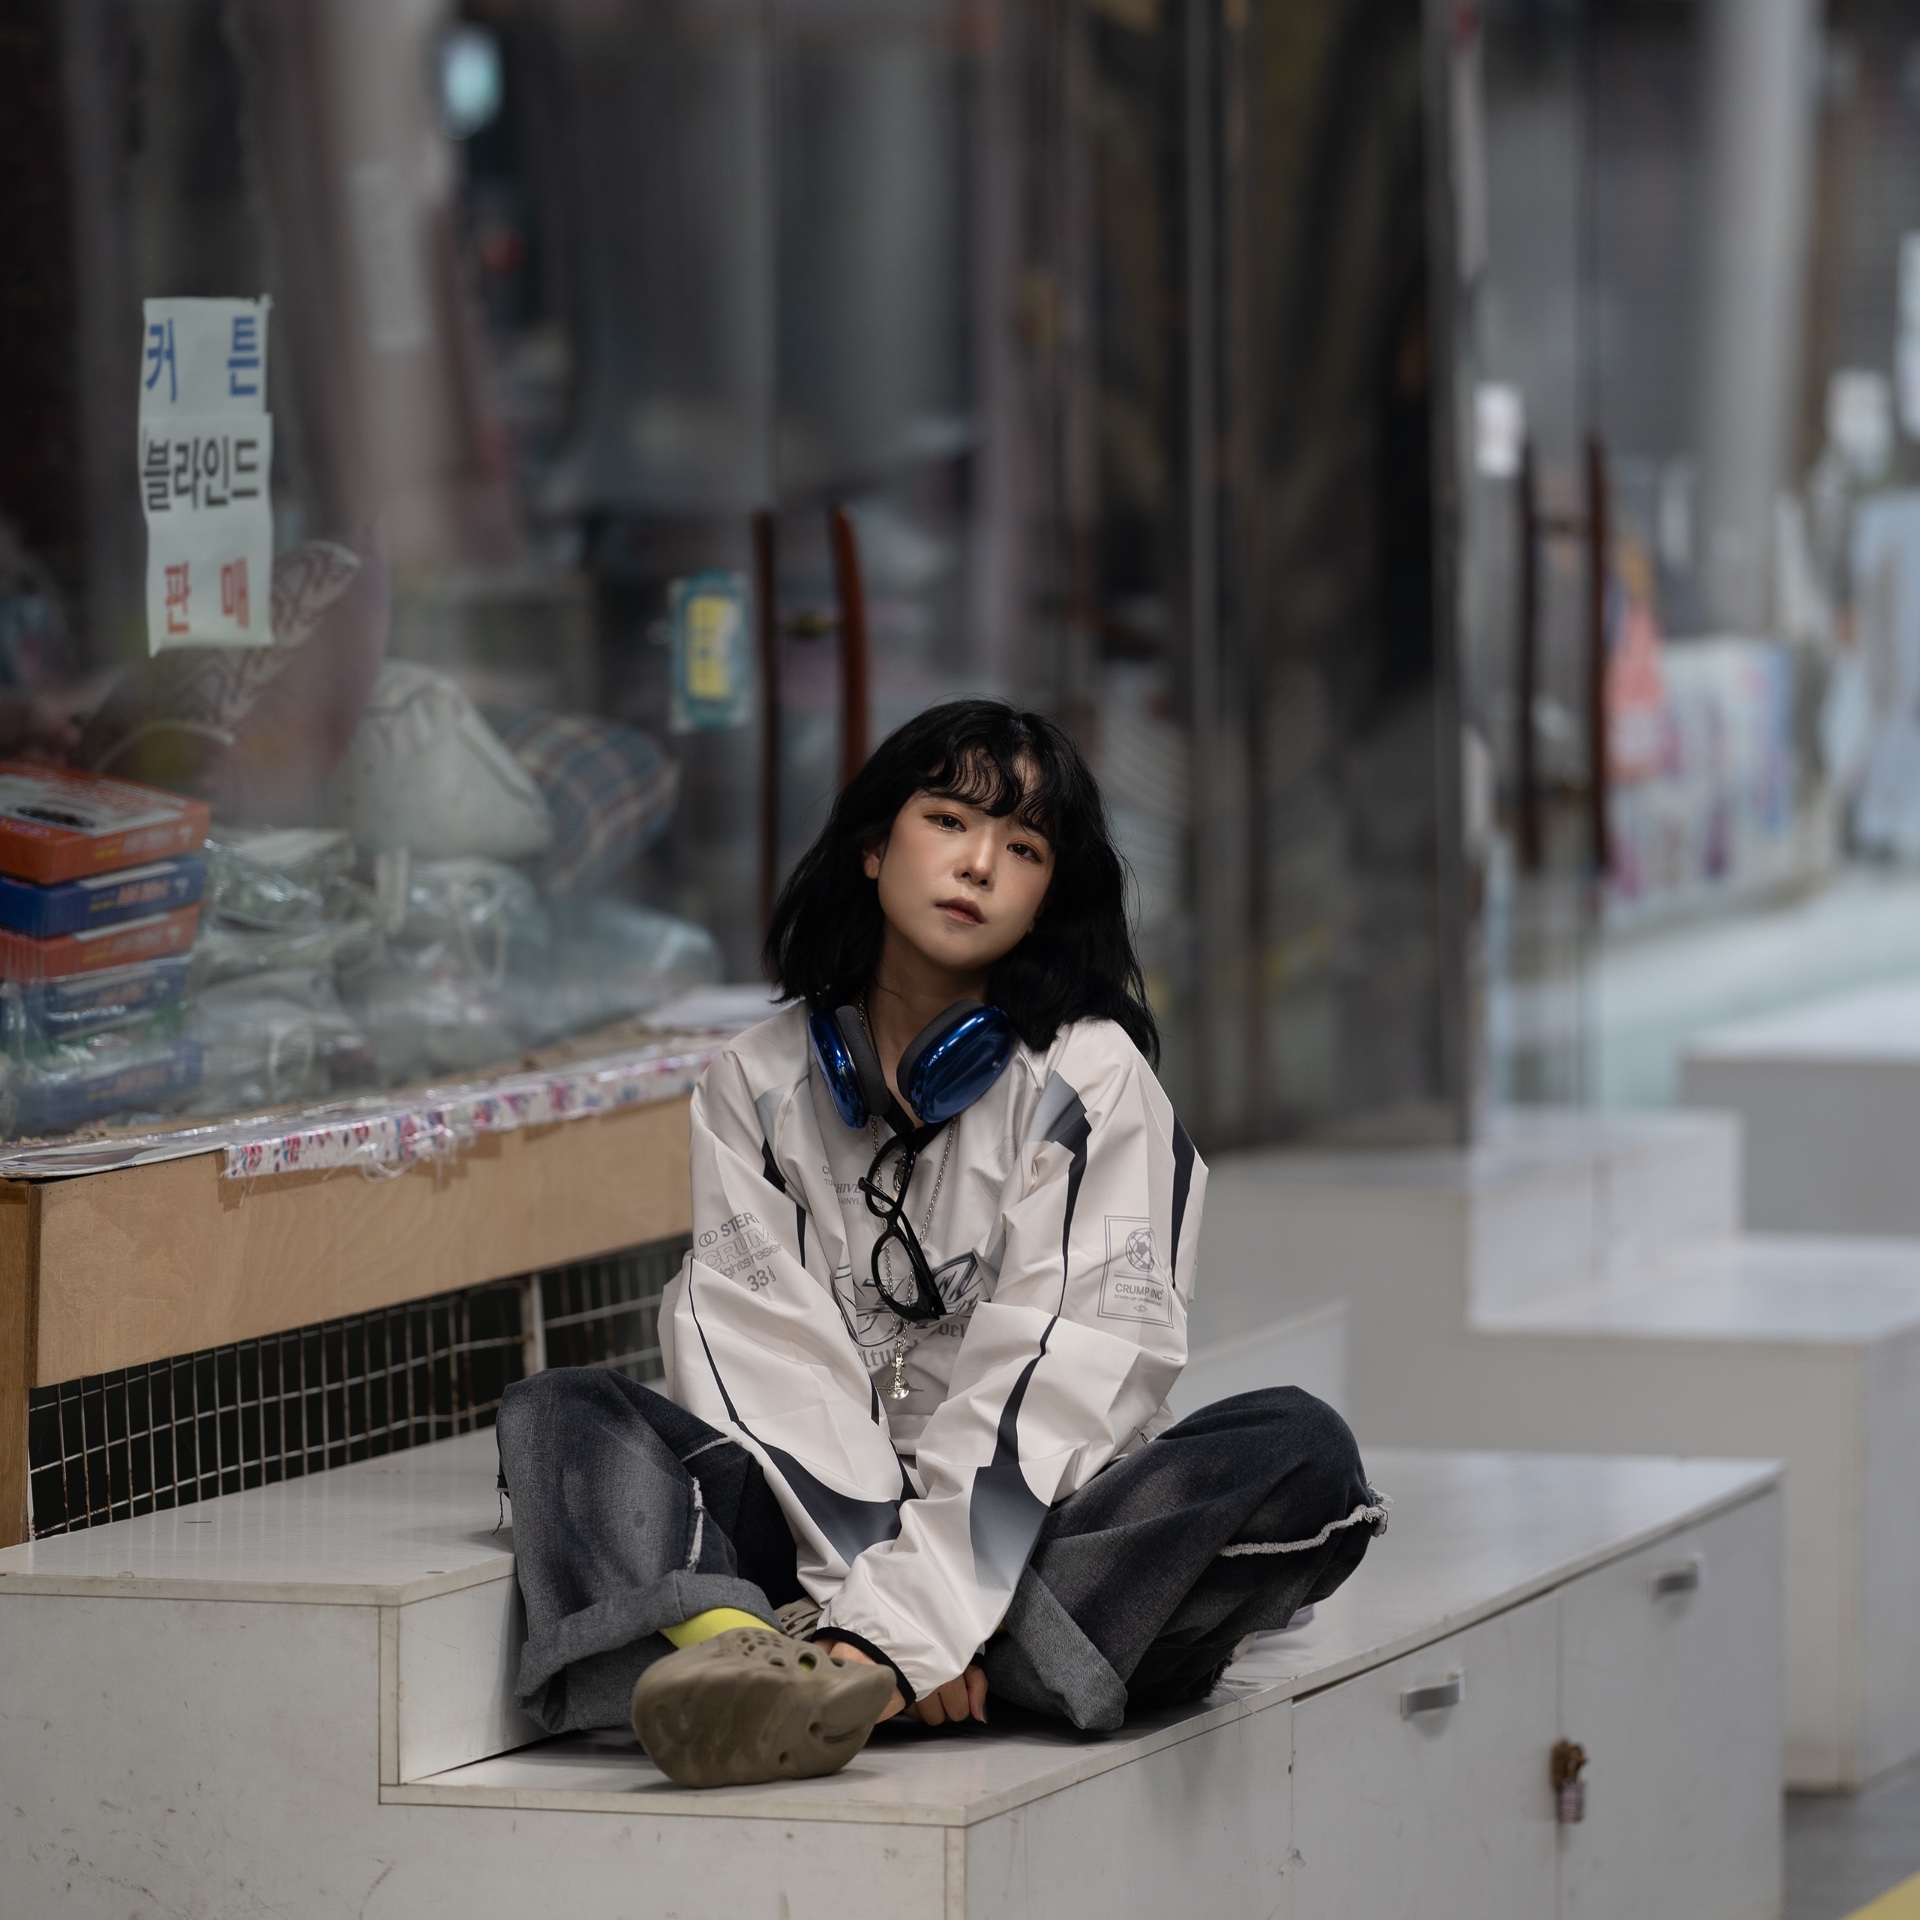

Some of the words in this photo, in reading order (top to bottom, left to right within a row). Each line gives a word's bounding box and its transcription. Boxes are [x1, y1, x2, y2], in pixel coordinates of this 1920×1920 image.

[143, 436, 260, 512] 블라인드
[720, 1212, 760, 1237] STER
[1115, 1283, 1150, 1297] CRUMP
